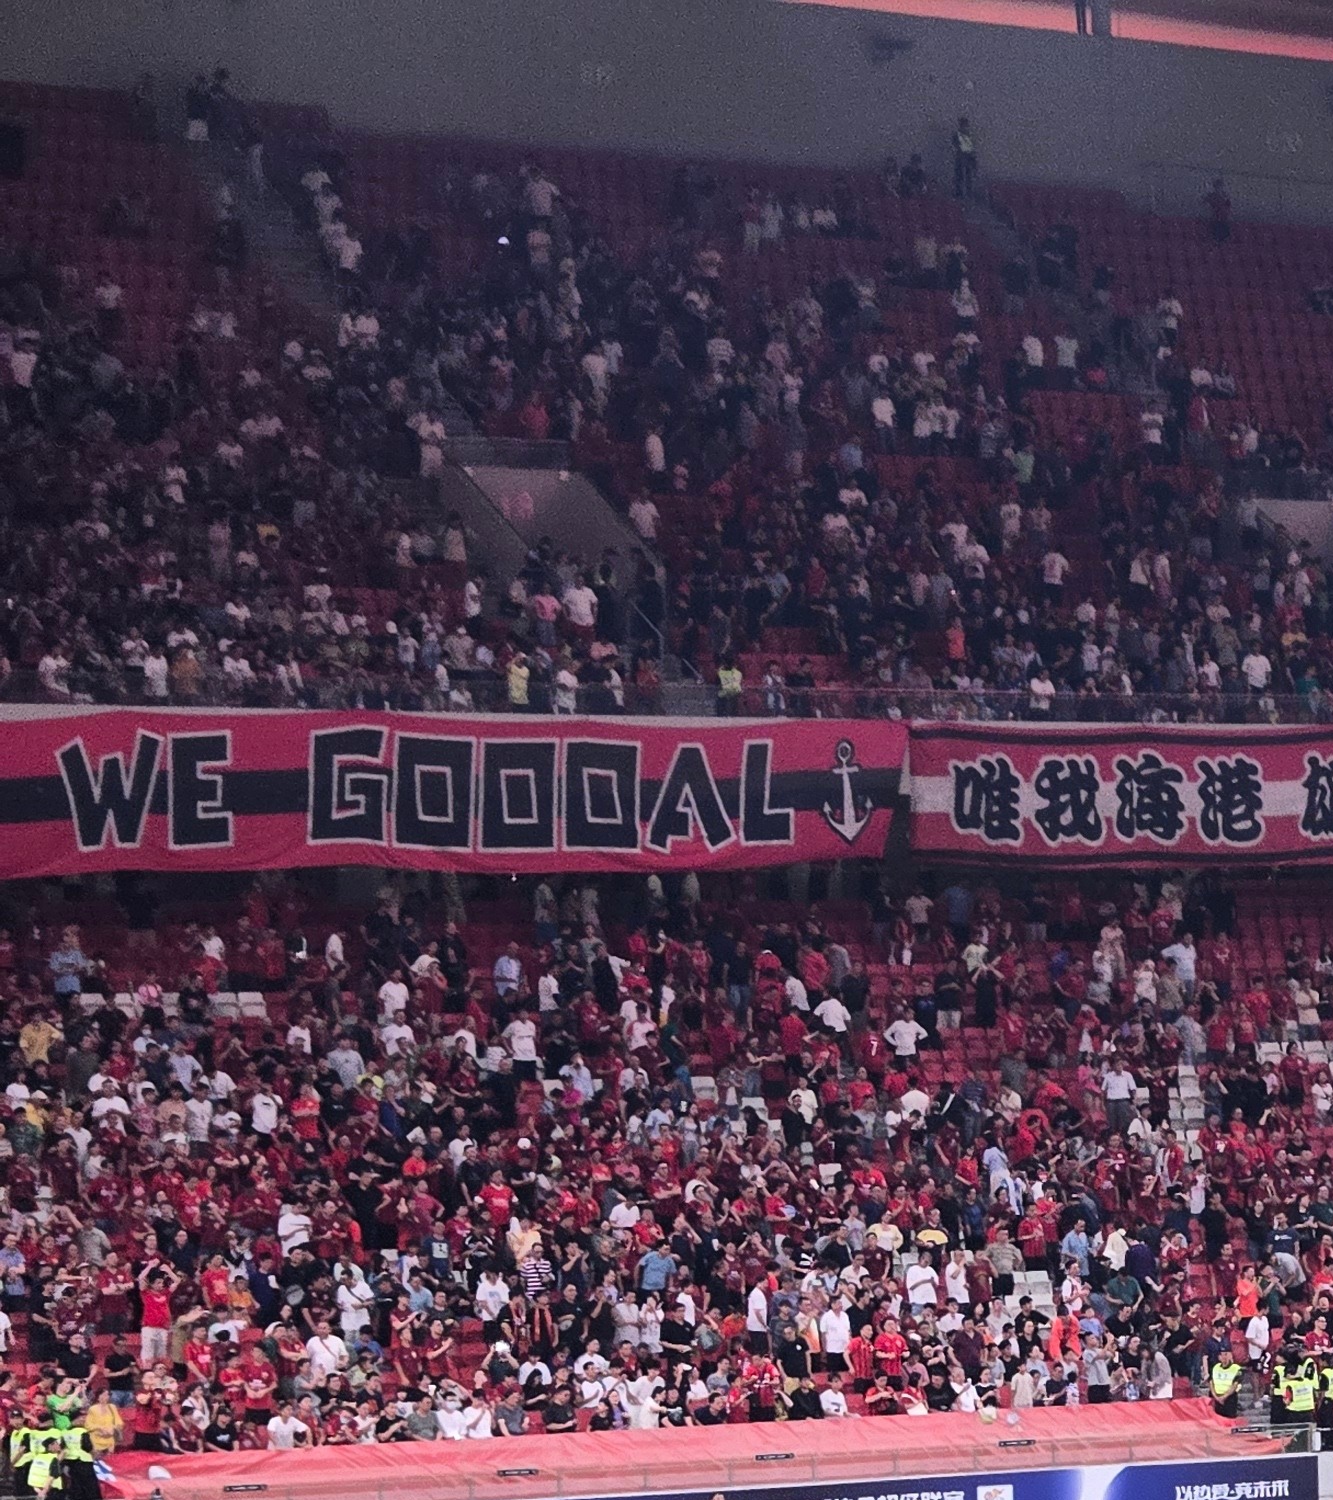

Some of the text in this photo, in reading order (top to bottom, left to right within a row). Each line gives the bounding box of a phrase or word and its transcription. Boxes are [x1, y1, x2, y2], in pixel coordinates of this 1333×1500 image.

[56, 724, 796, 854] WE GOOOAL
[951, 753, 1266, 845] 唯我海港
